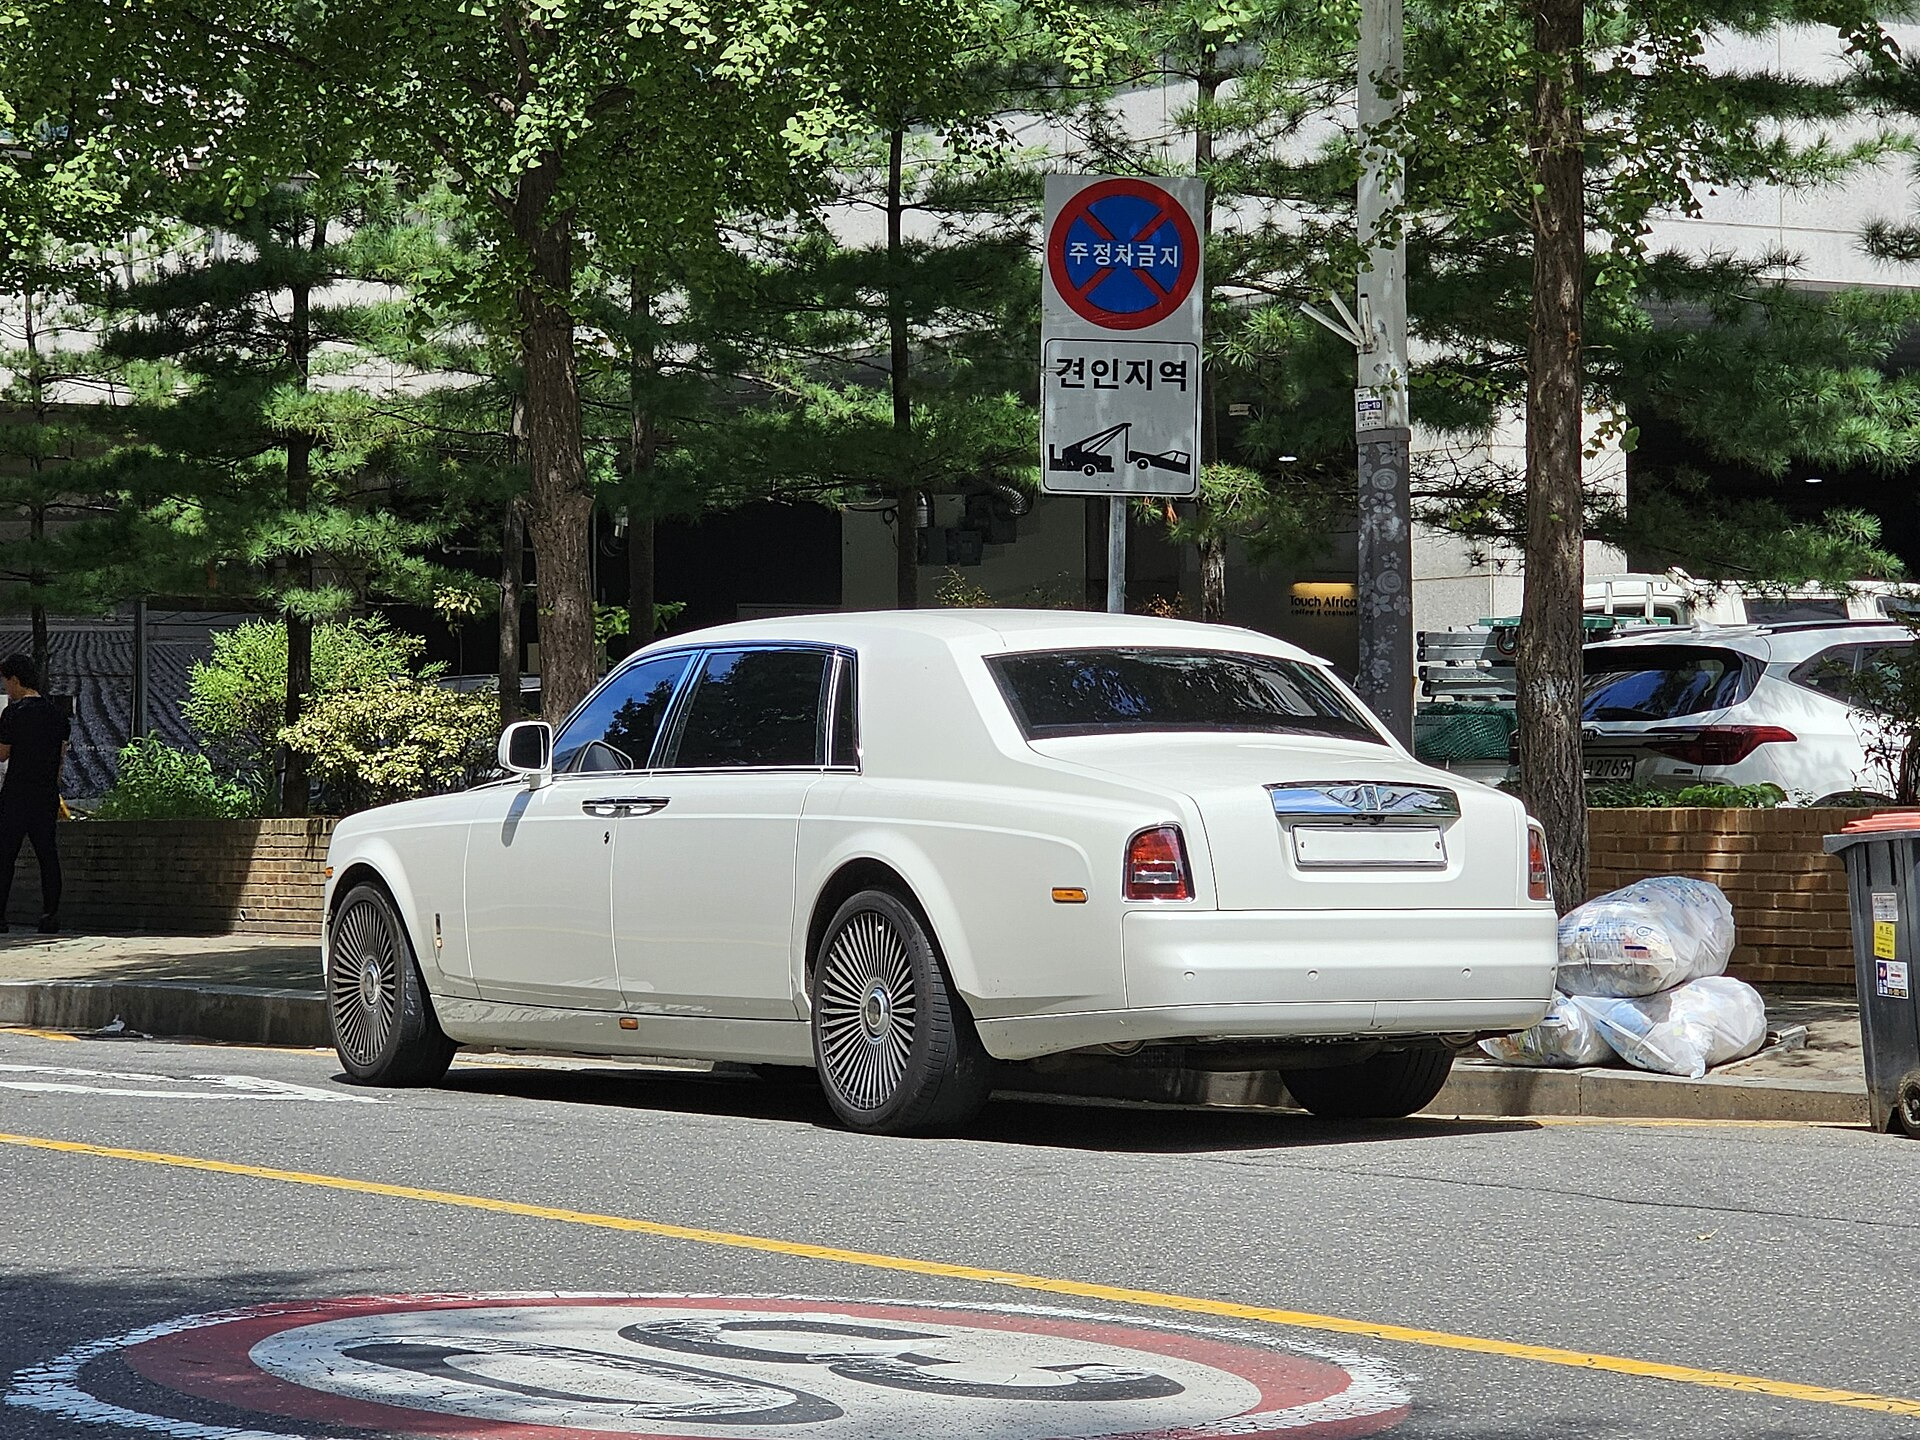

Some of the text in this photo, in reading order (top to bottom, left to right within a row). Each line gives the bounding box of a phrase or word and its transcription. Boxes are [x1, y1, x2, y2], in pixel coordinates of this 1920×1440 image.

[1069, 242, 1178, 268] 주정차금지
[1055, 357, 1187, 392] 견인지역
[1290, 595, 1321, 607] Touch
